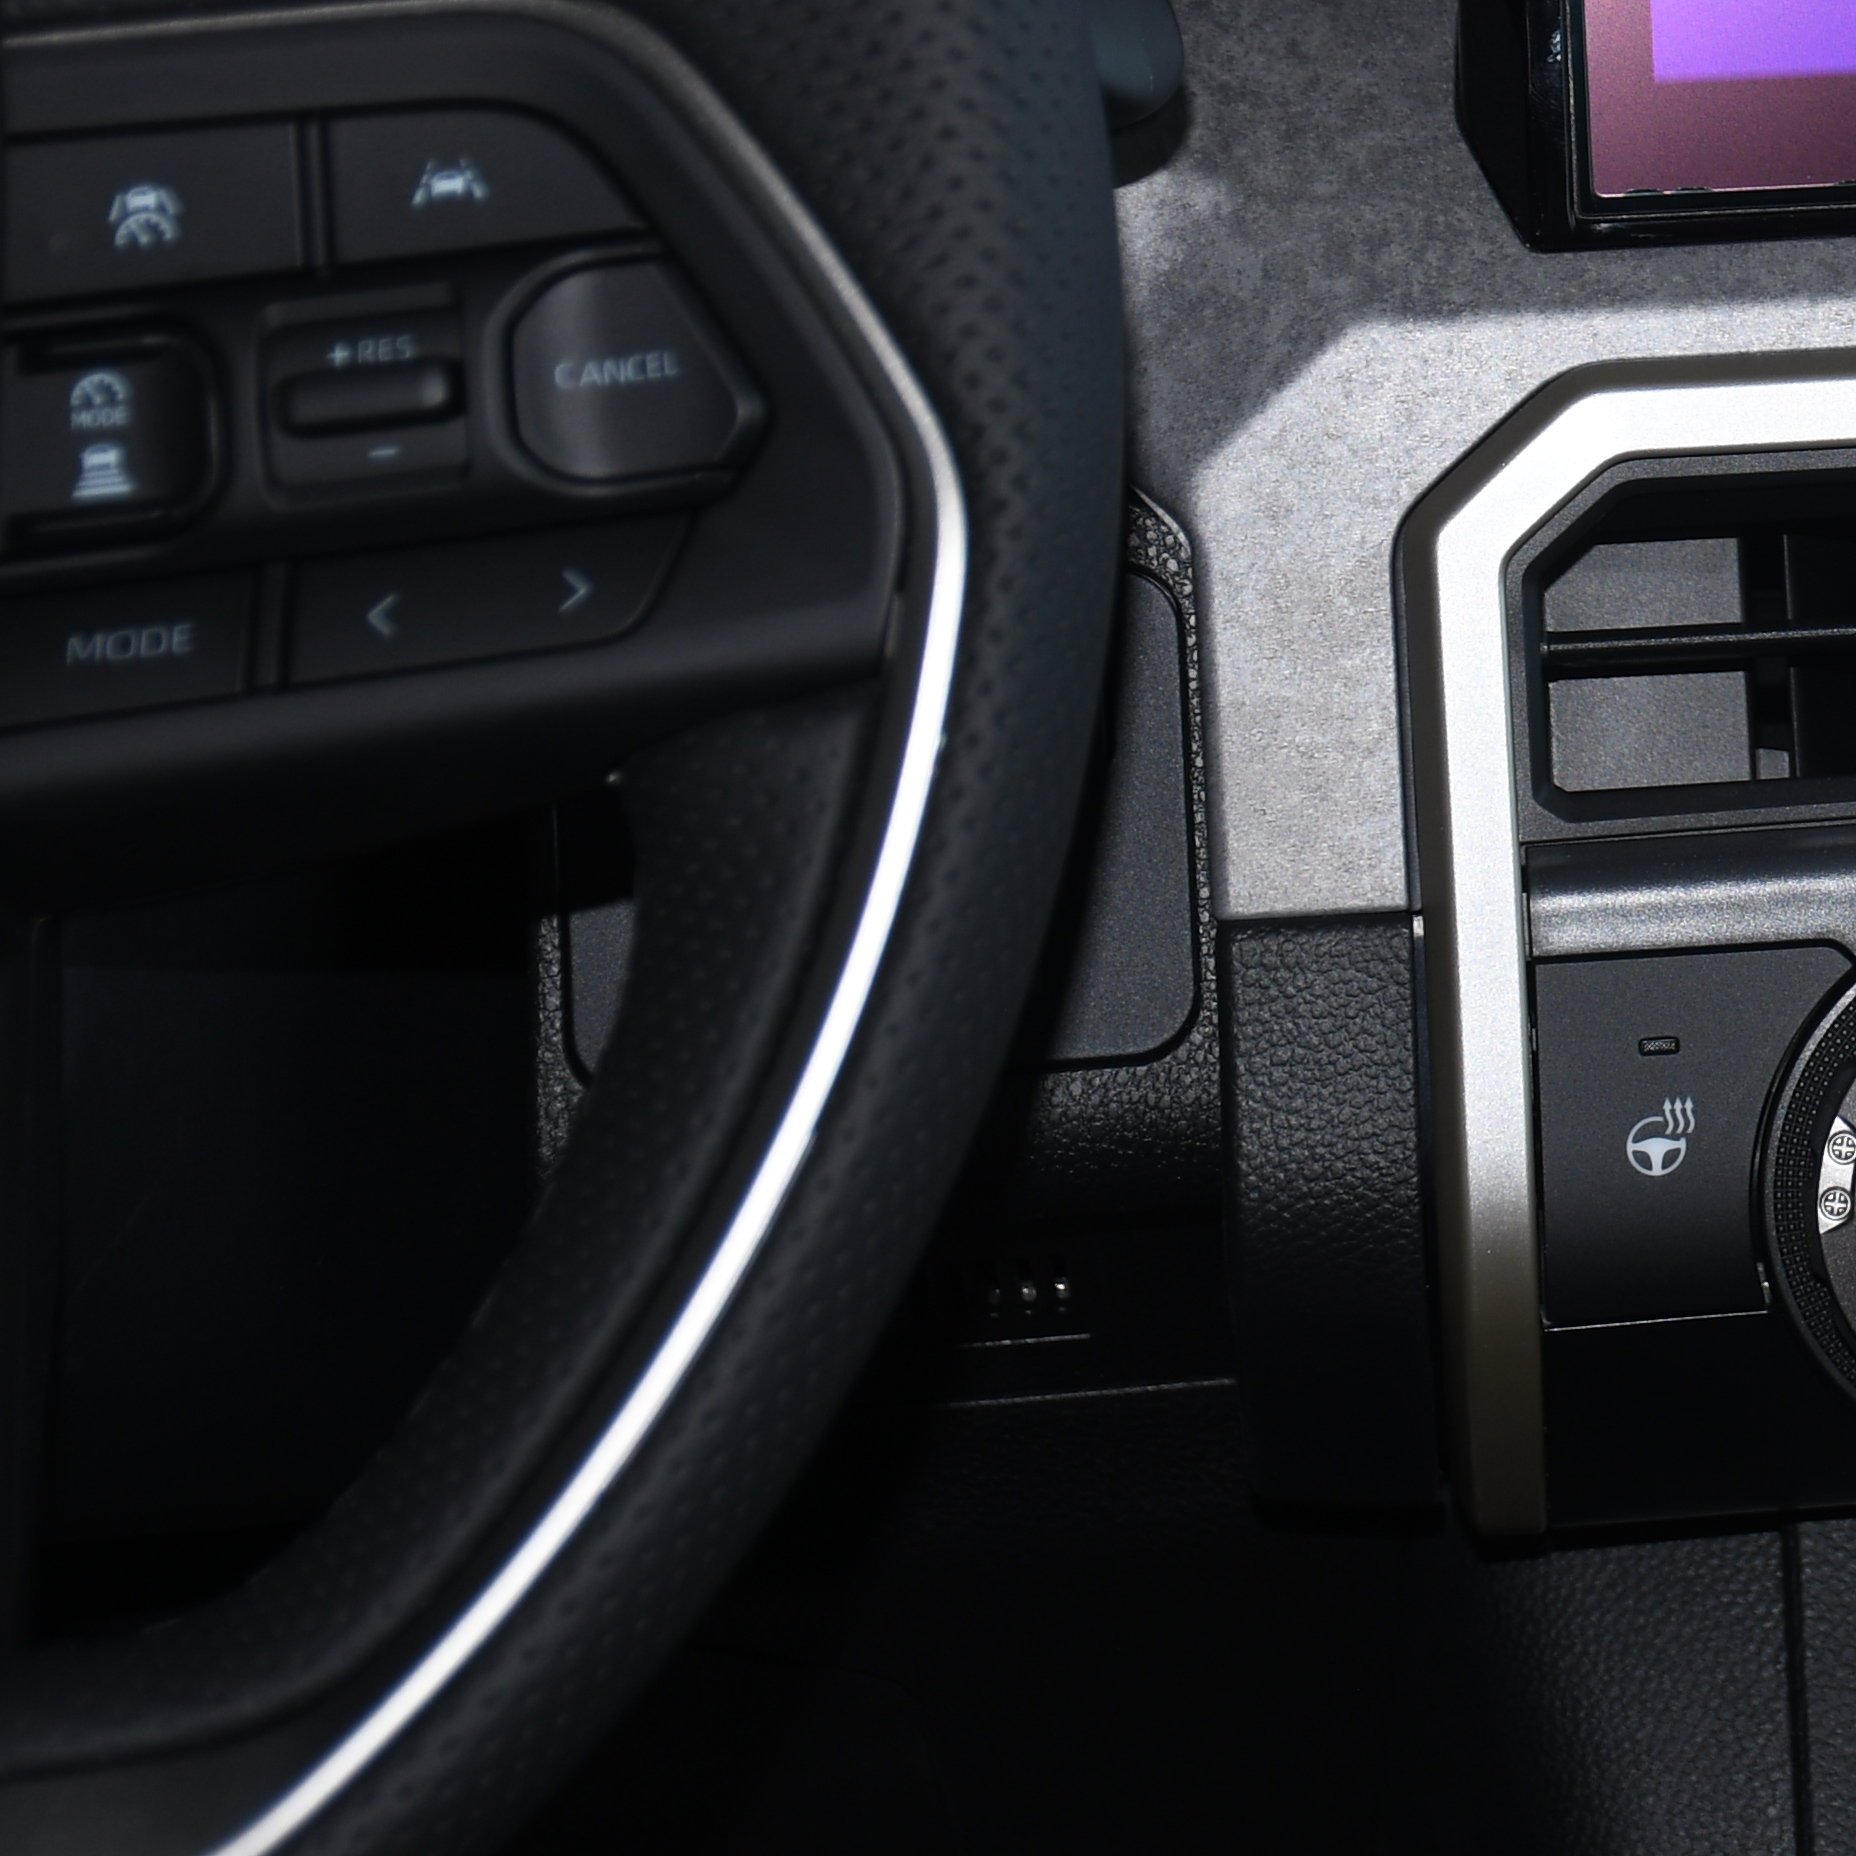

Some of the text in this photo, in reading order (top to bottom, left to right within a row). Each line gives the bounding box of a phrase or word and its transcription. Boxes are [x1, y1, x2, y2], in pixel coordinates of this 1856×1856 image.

[554, 351, 679, 390] CANCEL
[70, 405, 129, 430] MODE
[65, 623, 194, 667] MODE
